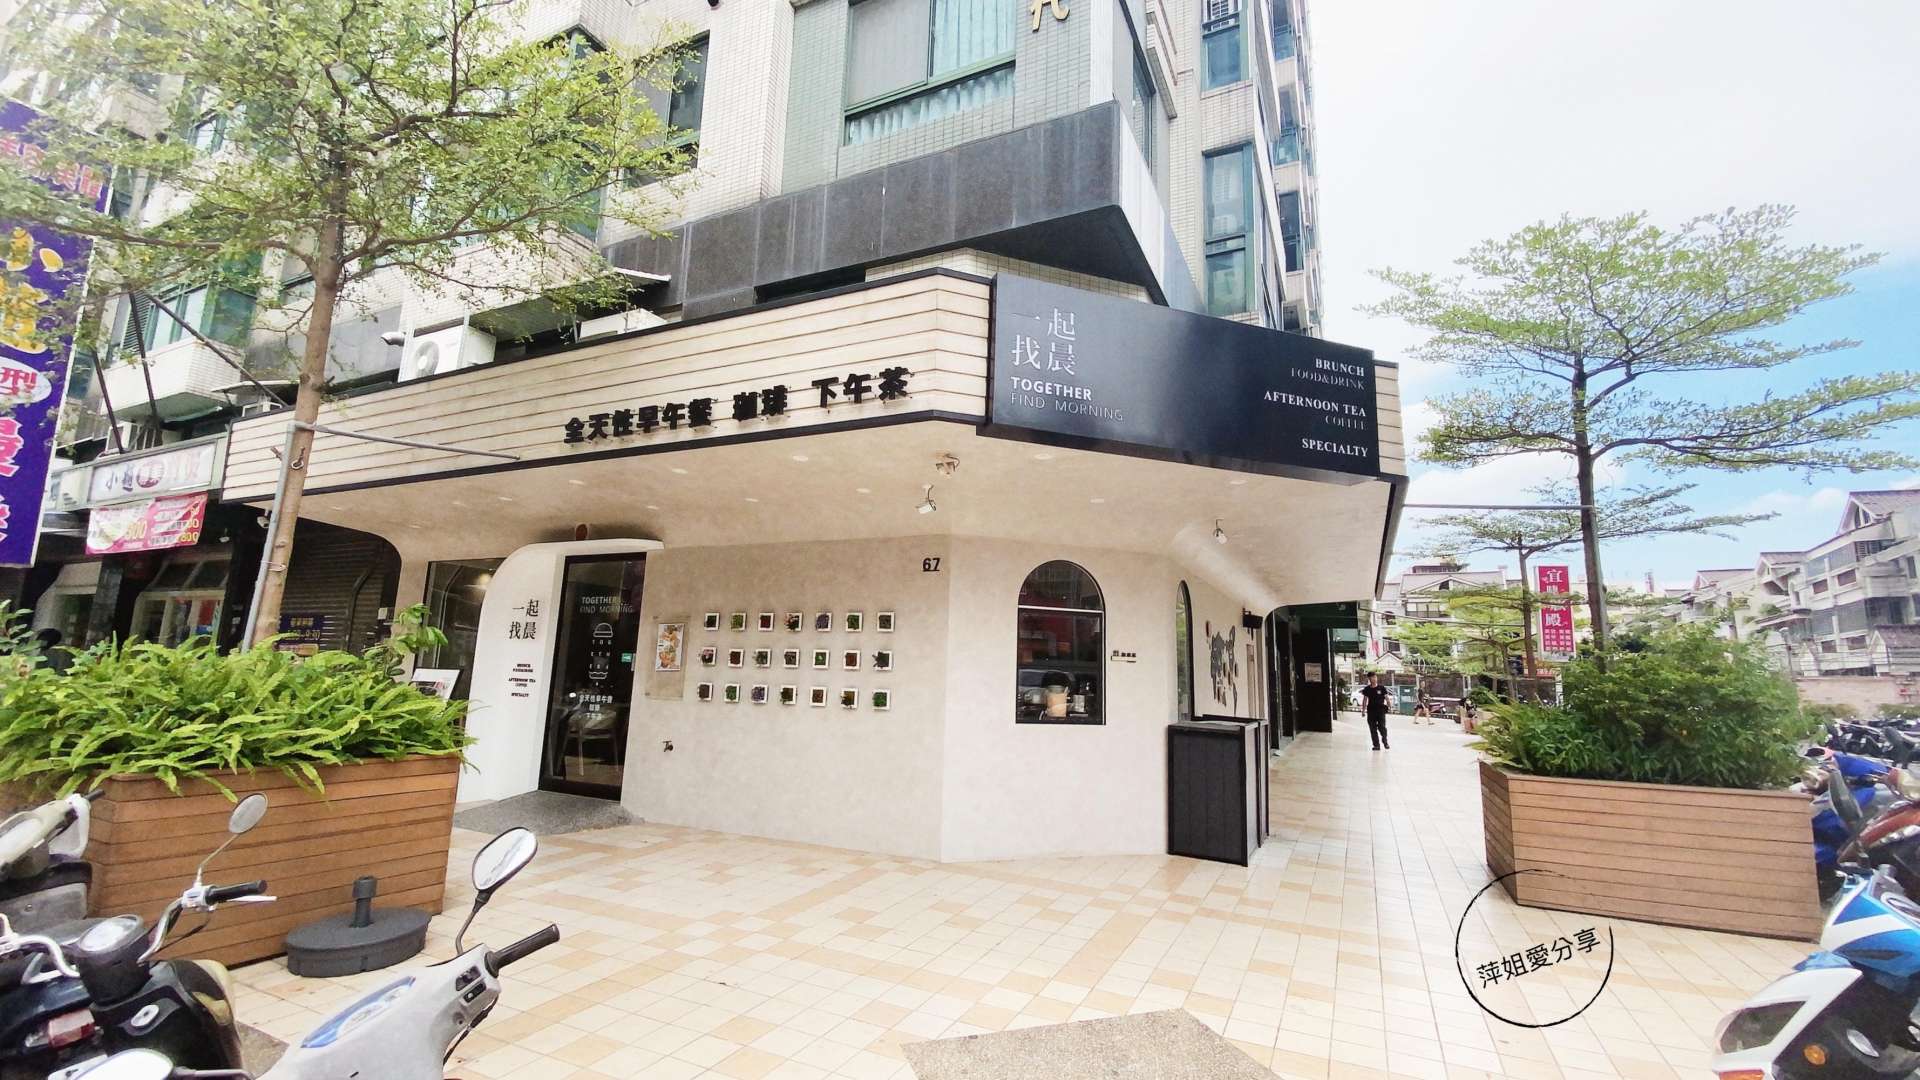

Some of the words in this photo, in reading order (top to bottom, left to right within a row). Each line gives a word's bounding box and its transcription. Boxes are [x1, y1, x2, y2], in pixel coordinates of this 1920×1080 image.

[1011, 308, 1076, 341] 一起
[1010, 334, 1076, 375] 找晨
[1315, 358, 1365, 377] BRUNCH
[811, 366, 912, 409] 下午茶
[1010, 376, 1092, 401] TOGETHER
[1011, 392, 1045, 409] FIND
[1055, 399, 1123, 421] MORNING
[1264, 390, 1339, 412] AFTERNOON
[1342, 403, 1366, 417] TEA
[1302, 438, 1369, 457] SPECIALTY
[922, 557, 941, 572] 67
[512, 599, 539, 617] 一起
[509, 621, 537, 640] 找晨
